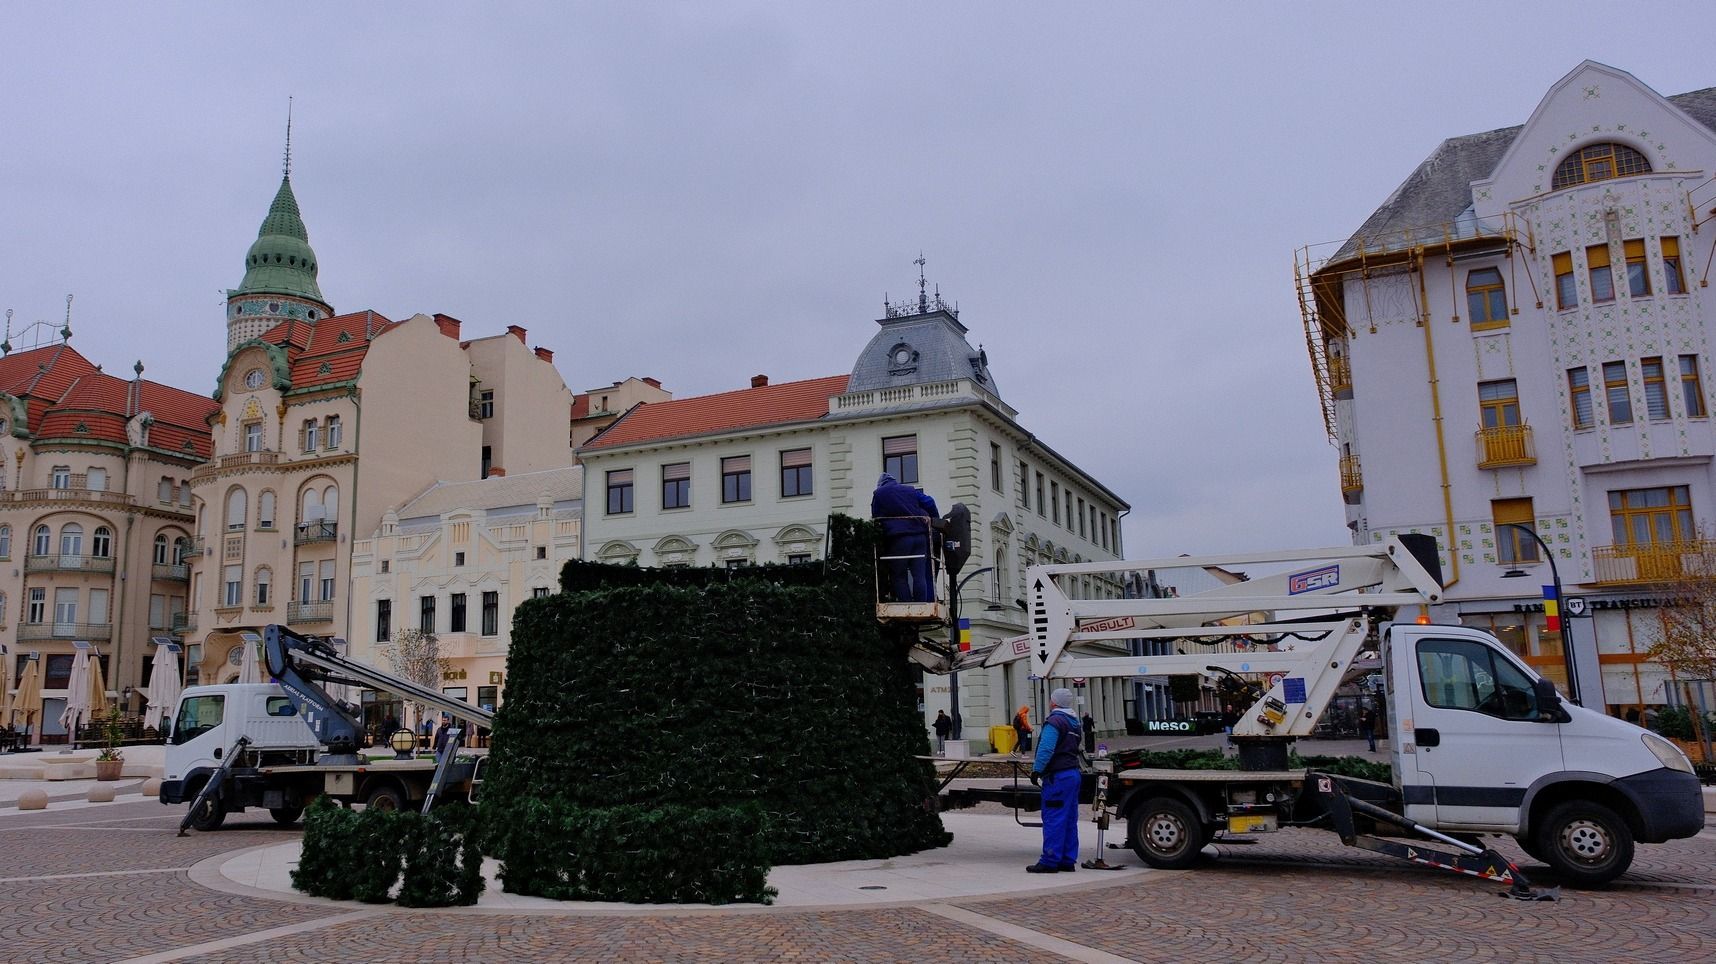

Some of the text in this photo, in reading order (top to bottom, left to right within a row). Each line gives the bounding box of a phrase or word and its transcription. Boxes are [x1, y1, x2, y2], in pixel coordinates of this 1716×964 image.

[1290, 571, 1338, 593] GSR
[1569, 601, 1582, 609] BT
[283, 684, 324, 711] AERIAL PLATFORM
